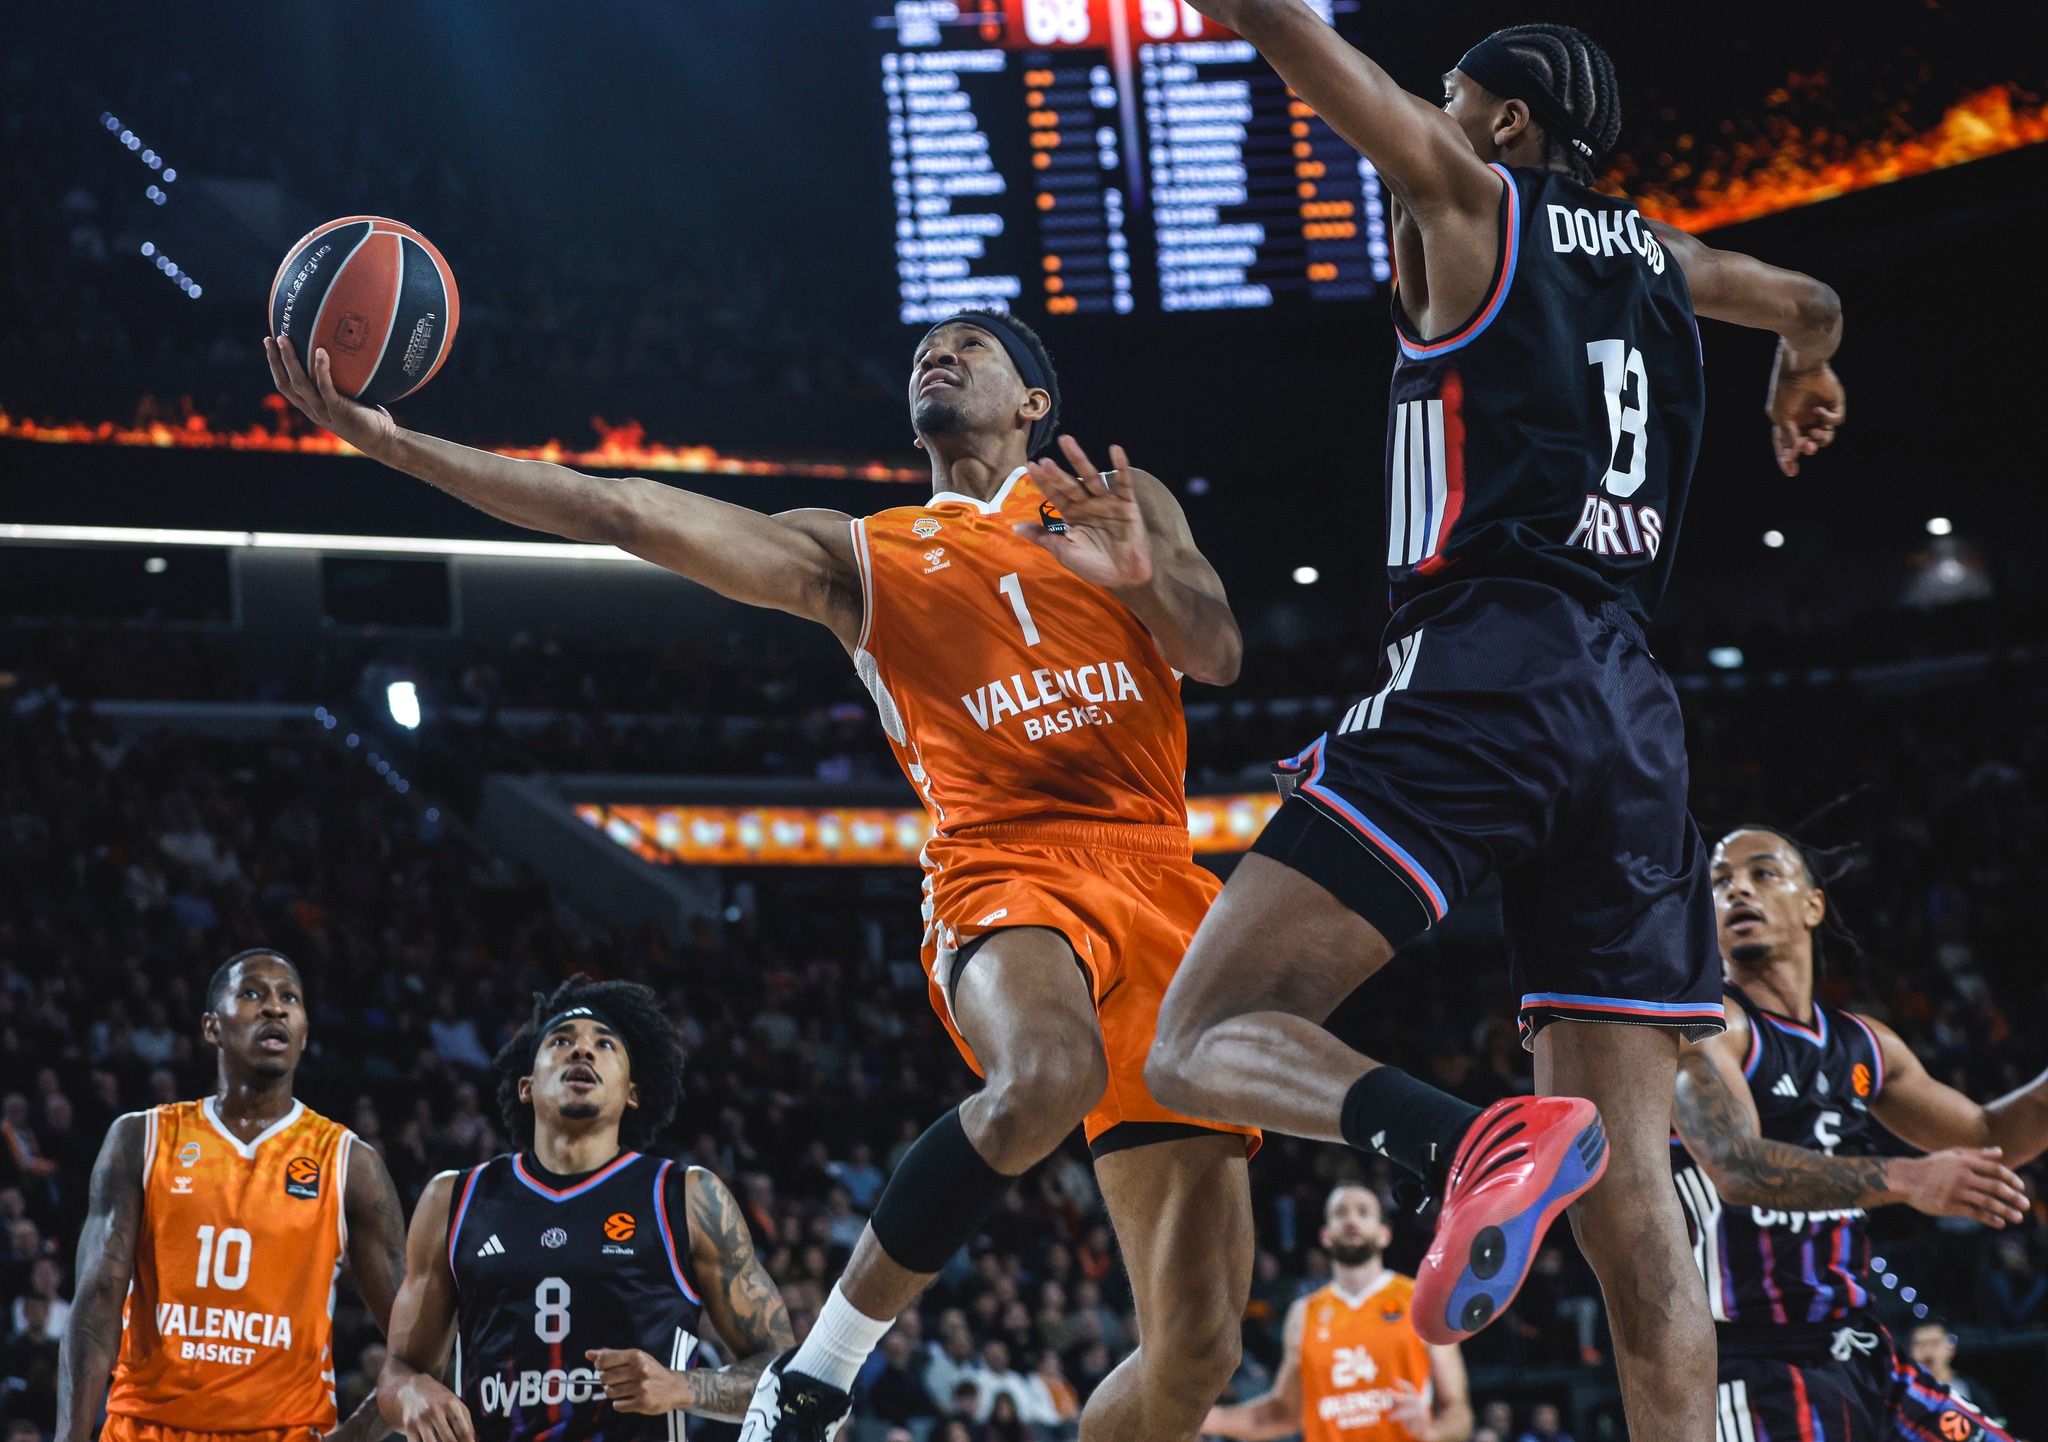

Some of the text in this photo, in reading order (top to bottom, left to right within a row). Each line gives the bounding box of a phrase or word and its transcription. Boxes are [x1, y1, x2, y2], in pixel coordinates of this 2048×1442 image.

[1586, 338, 1649, 498] 13
[1565, 494, 1663, 561] PARIS
[1000, 572, 1041, 647] 1
[961, 661, 1144, 732] VALENCIA
[195, 1224, 252, 1291] 10
[155, 1302, 292, 1350] VALENCIA
[534, 1276, 571, 1344] 8
[181, 1341, 256, 1365] BASKET
